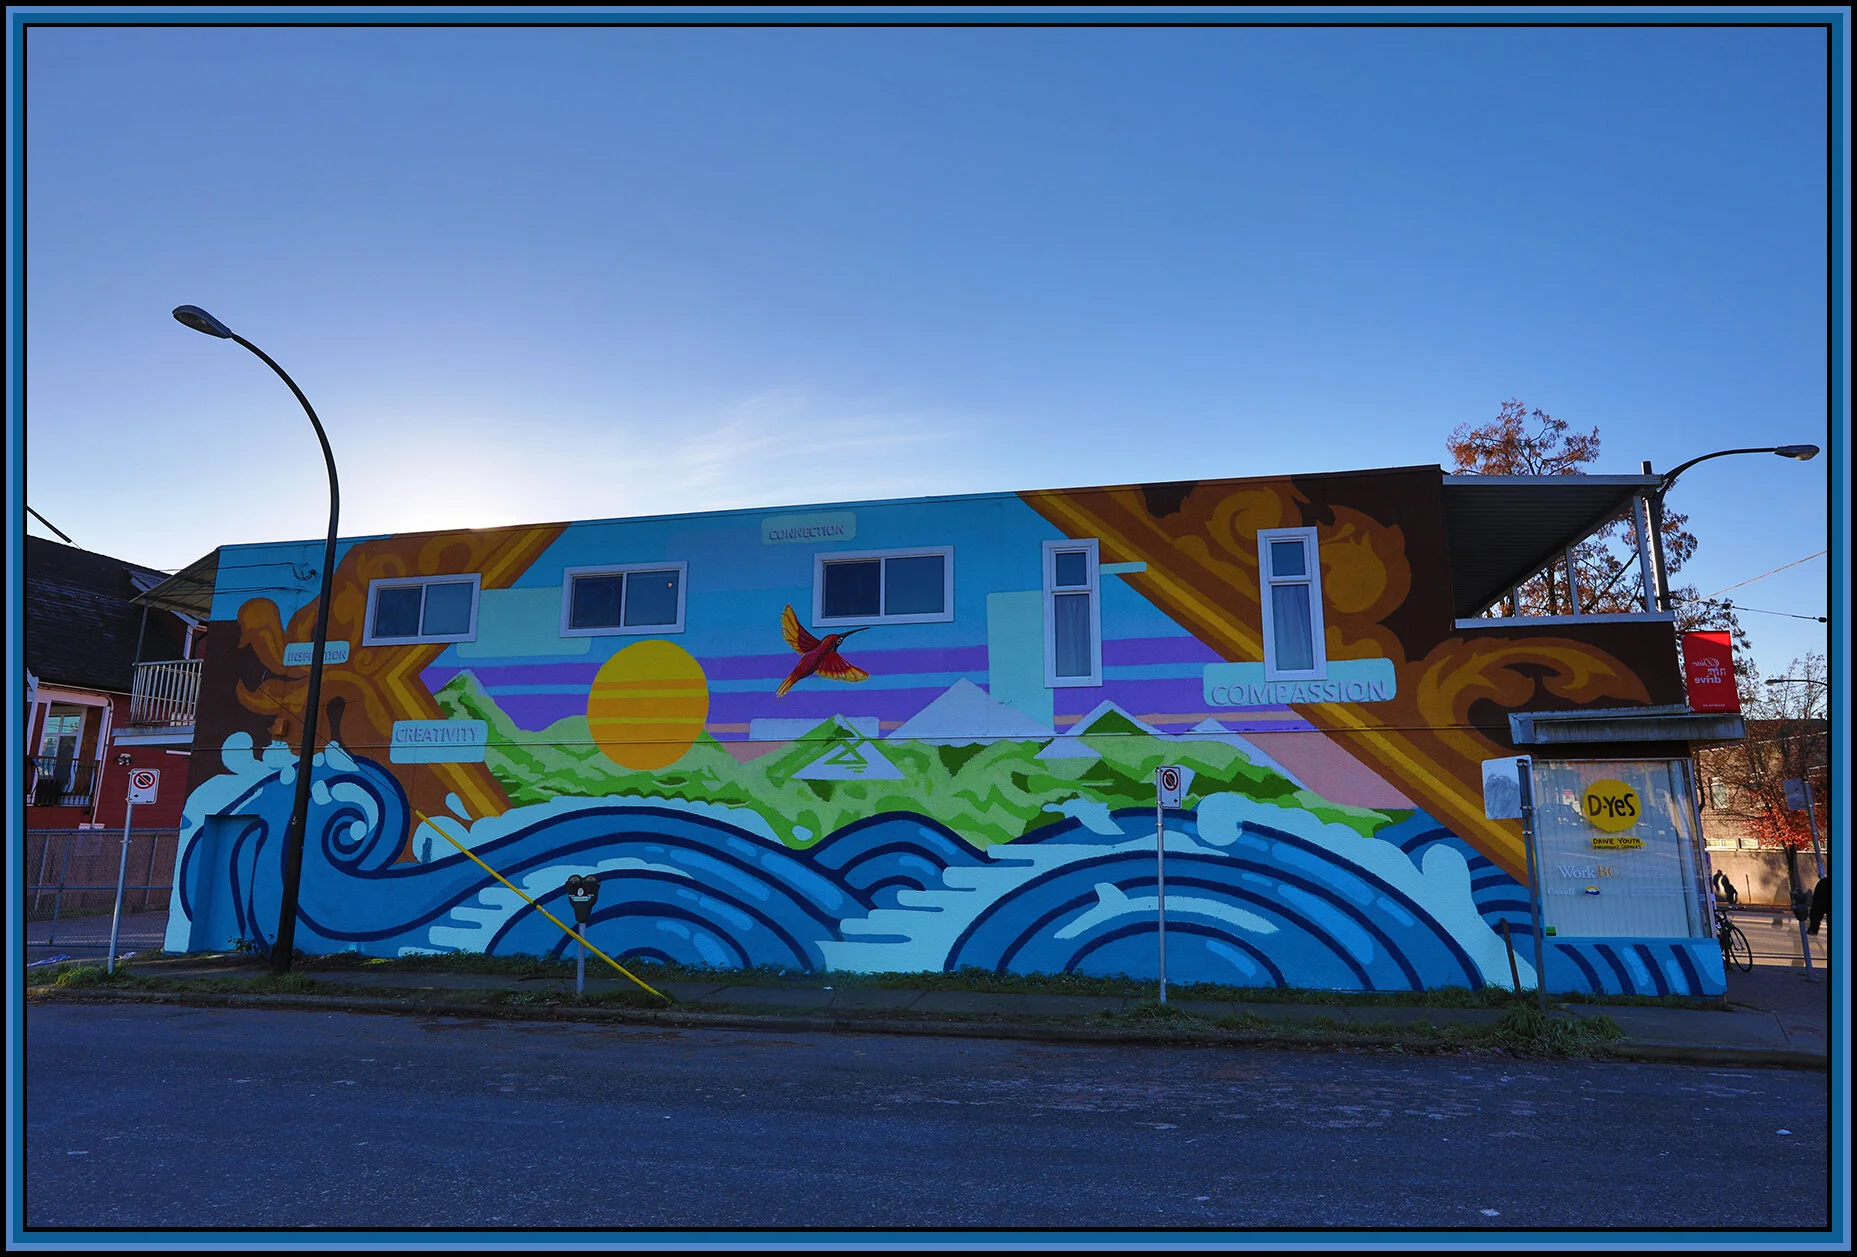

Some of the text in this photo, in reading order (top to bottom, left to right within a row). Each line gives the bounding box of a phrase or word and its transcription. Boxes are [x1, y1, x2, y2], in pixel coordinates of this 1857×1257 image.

[768, 524, 846, 541] CONNECTION
[287, 650, 347, 662] INSPITION
[1211, 680, 1388, 706] COMPASSION
[395, 727, 479, 743] CREATIVITY
